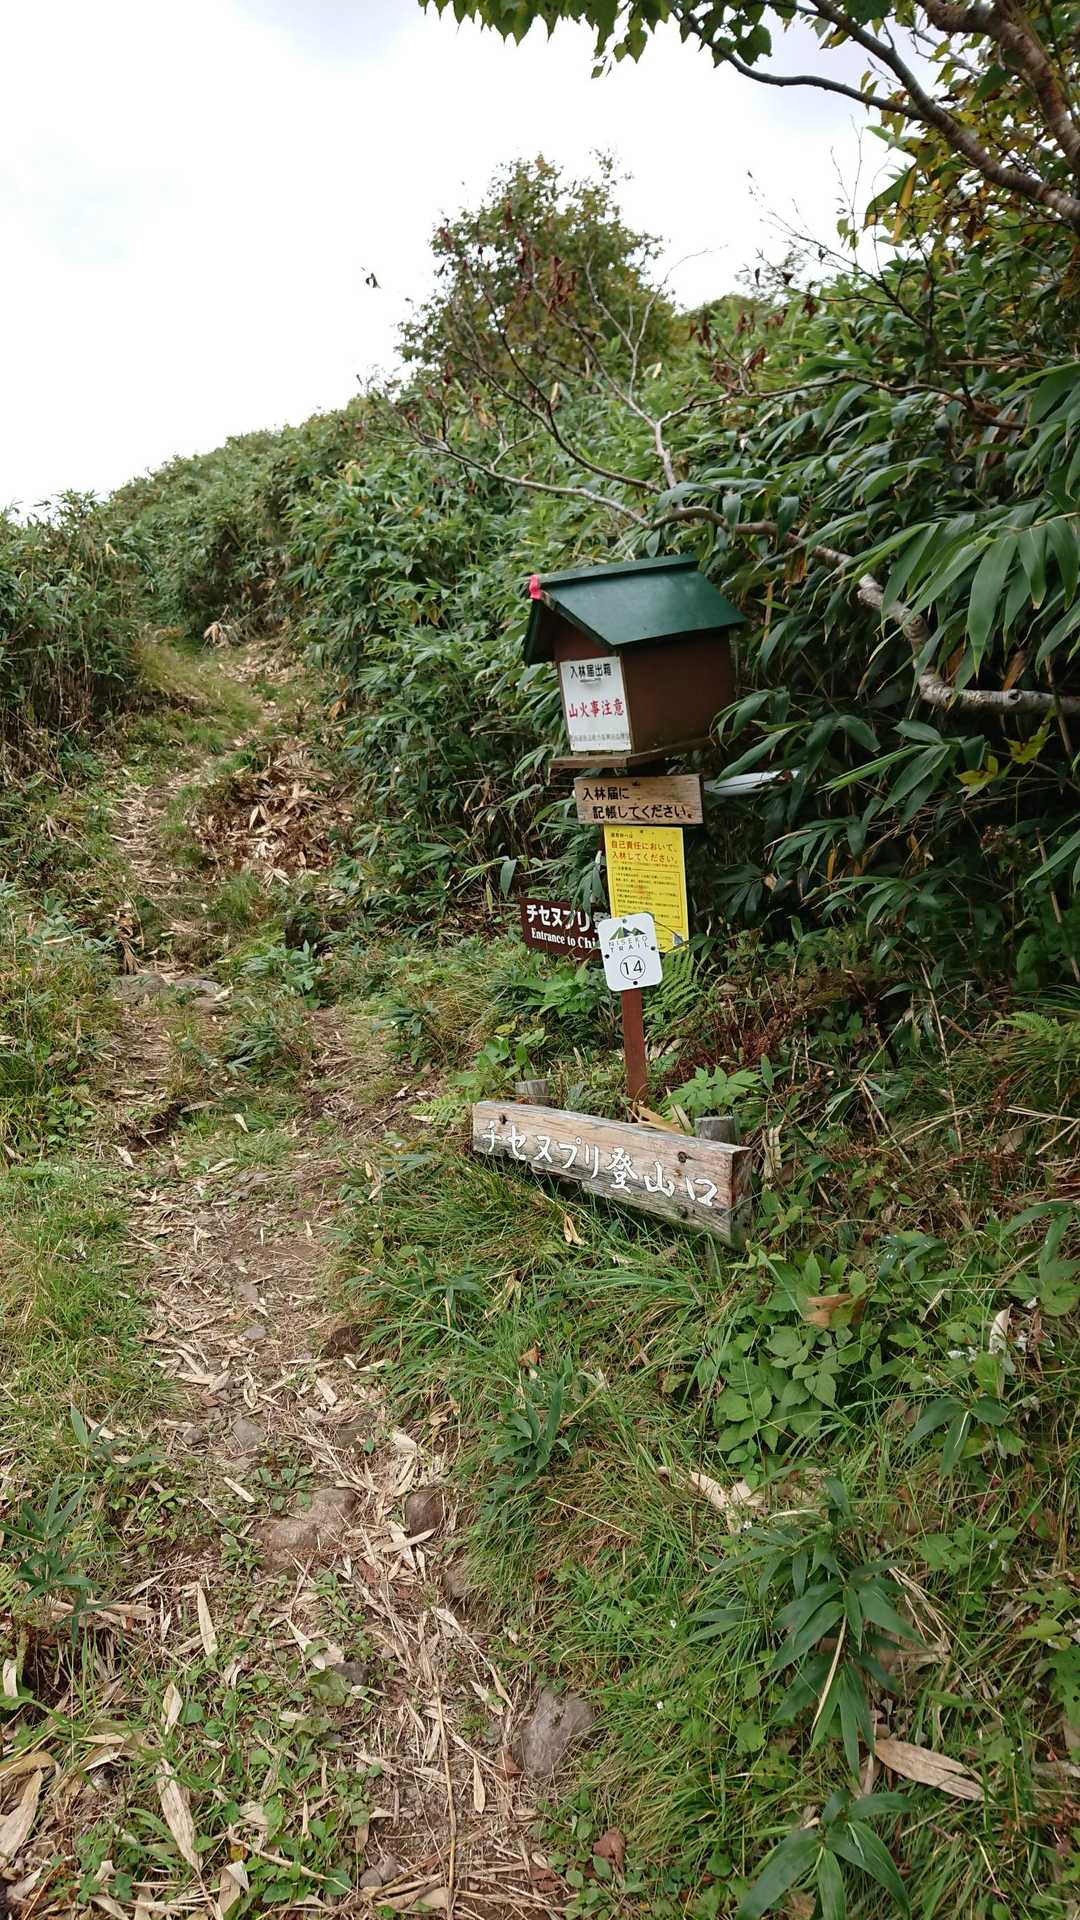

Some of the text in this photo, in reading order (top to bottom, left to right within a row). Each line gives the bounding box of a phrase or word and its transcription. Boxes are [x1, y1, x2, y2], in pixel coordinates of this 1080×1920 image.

[570, 663, 612, 679] 入林届出箱
[568, 698, 624, 718] 山火事注意
[582, 786, 630, 801] 入林届に
[592, 804, 692, 820] 記帳してください。
[531, 927, 566, 945] Entrance
[567, 935, 576, 947] to
[608, 935, 648, 947] NISEKO
[610, 943, 649, 953] TRAIL
[623, 960, 643, 976] 14
[482, 1120, 719, 1207] チセヌプリ登山口
